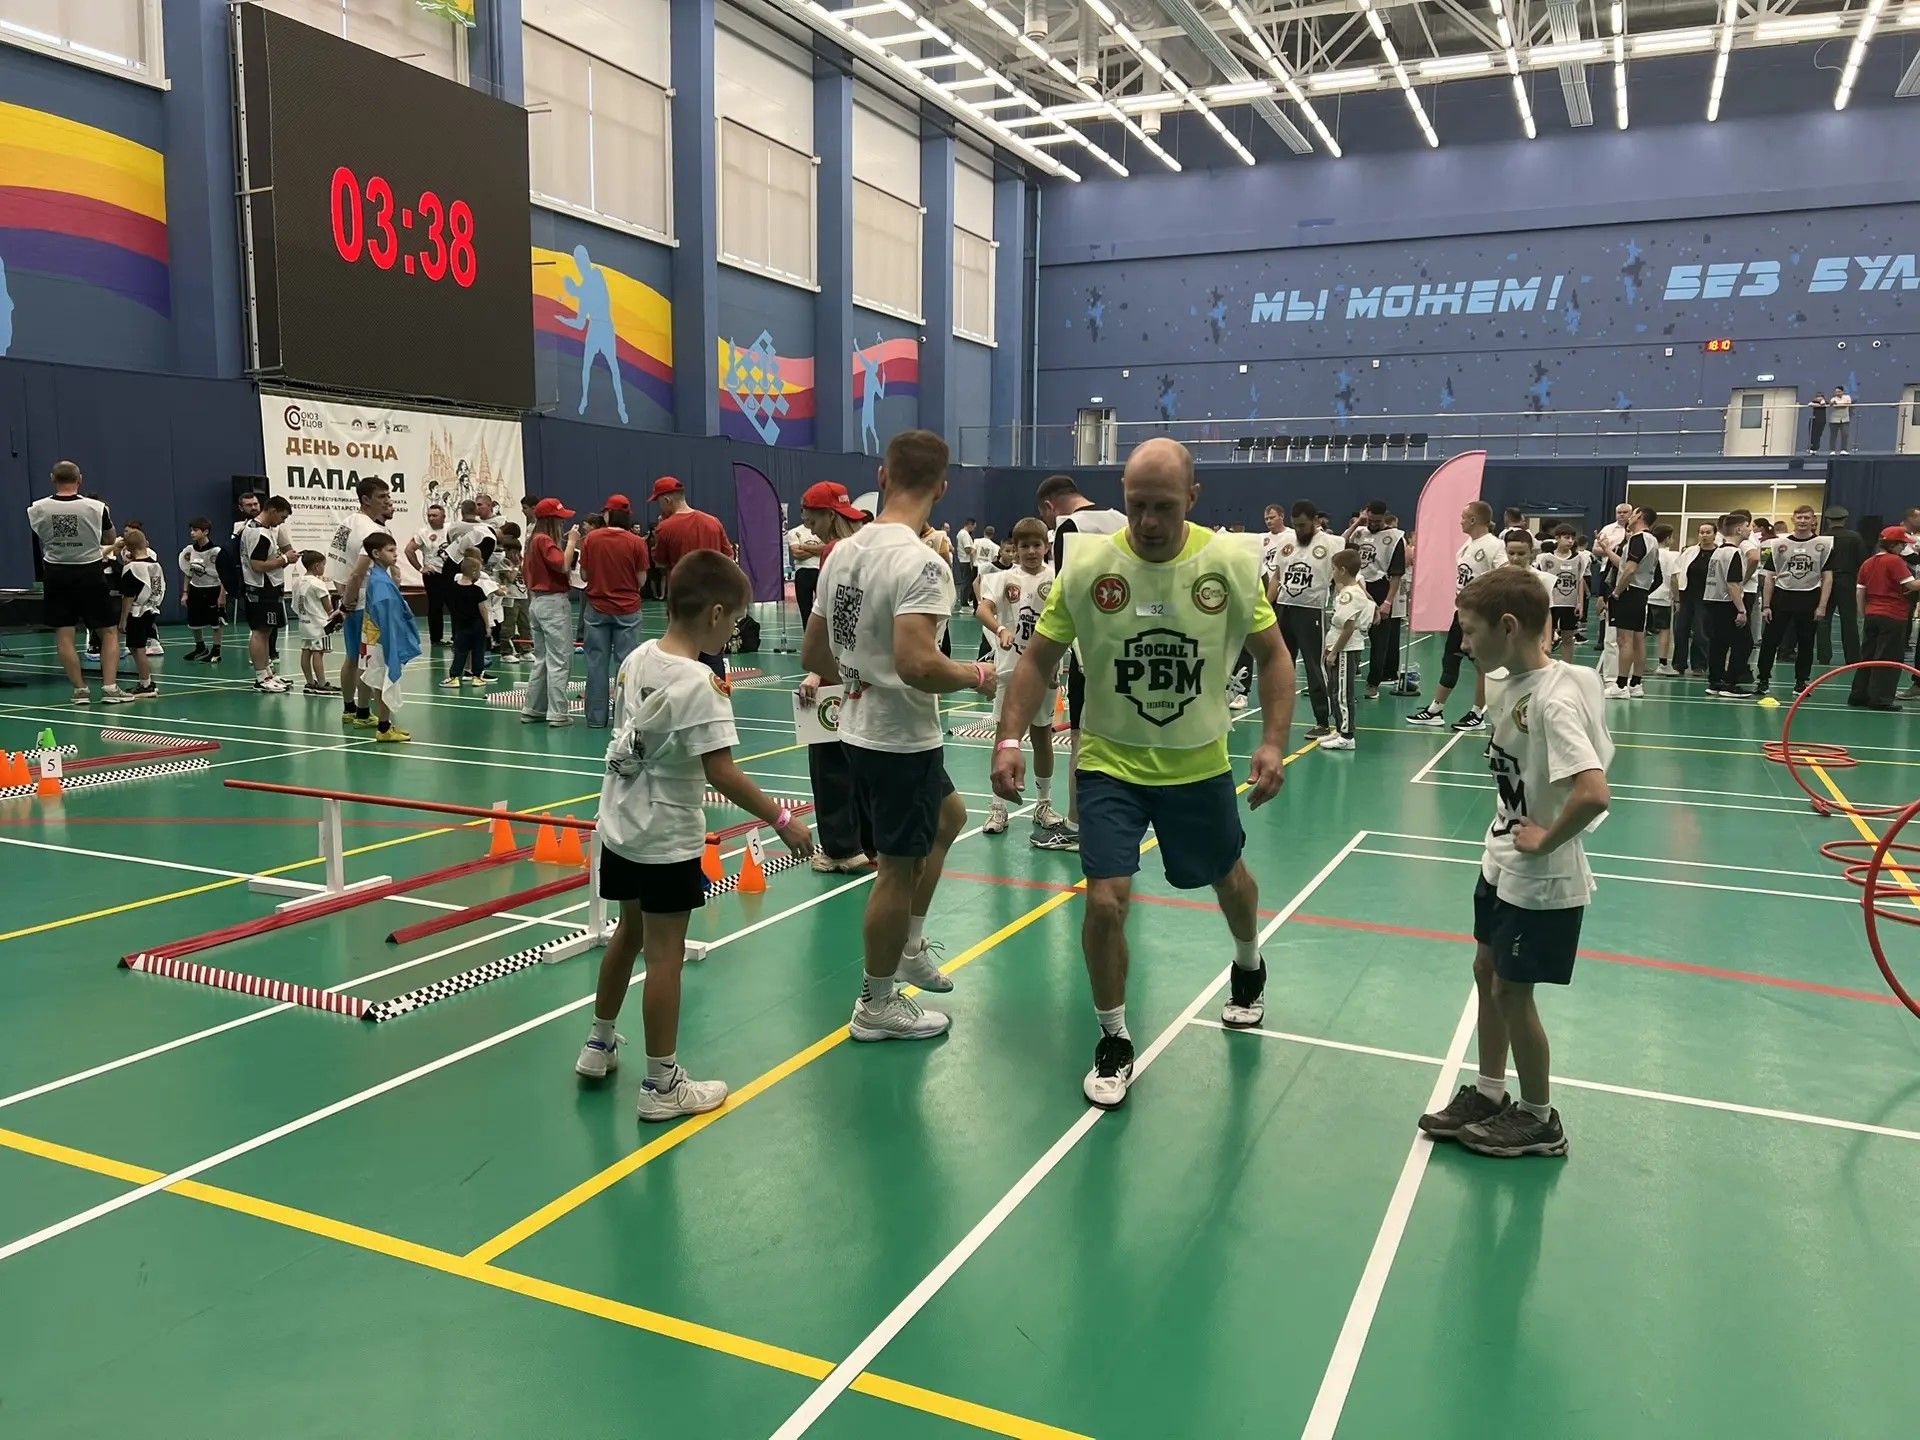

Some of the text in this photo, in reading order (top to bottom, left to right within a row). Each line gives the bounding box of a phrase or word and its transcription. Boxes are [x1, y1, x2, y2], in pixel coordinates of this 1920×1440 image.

[331, 166, 477, 288] 03:38
[1663, 260, 1781, 300] БЕЗ
[1251, 289, 1329, 323] МЫ
[286, 436, 399, 462] ДЕНЬ ОТЦА
[287, 466, 405, 493] ПАПА Я
[1787, 561, 1814, 572] РБМ
[1284, 572, 1314, 588] РБМ
[1150, 604, 1164, 615] 32
[1134, 643, 1189, 659] SOCIAL
[1114, 658, 1206, 695] РБМ
[47, 758, 56, 772] 5
[752, 838, 760, 856] 5
